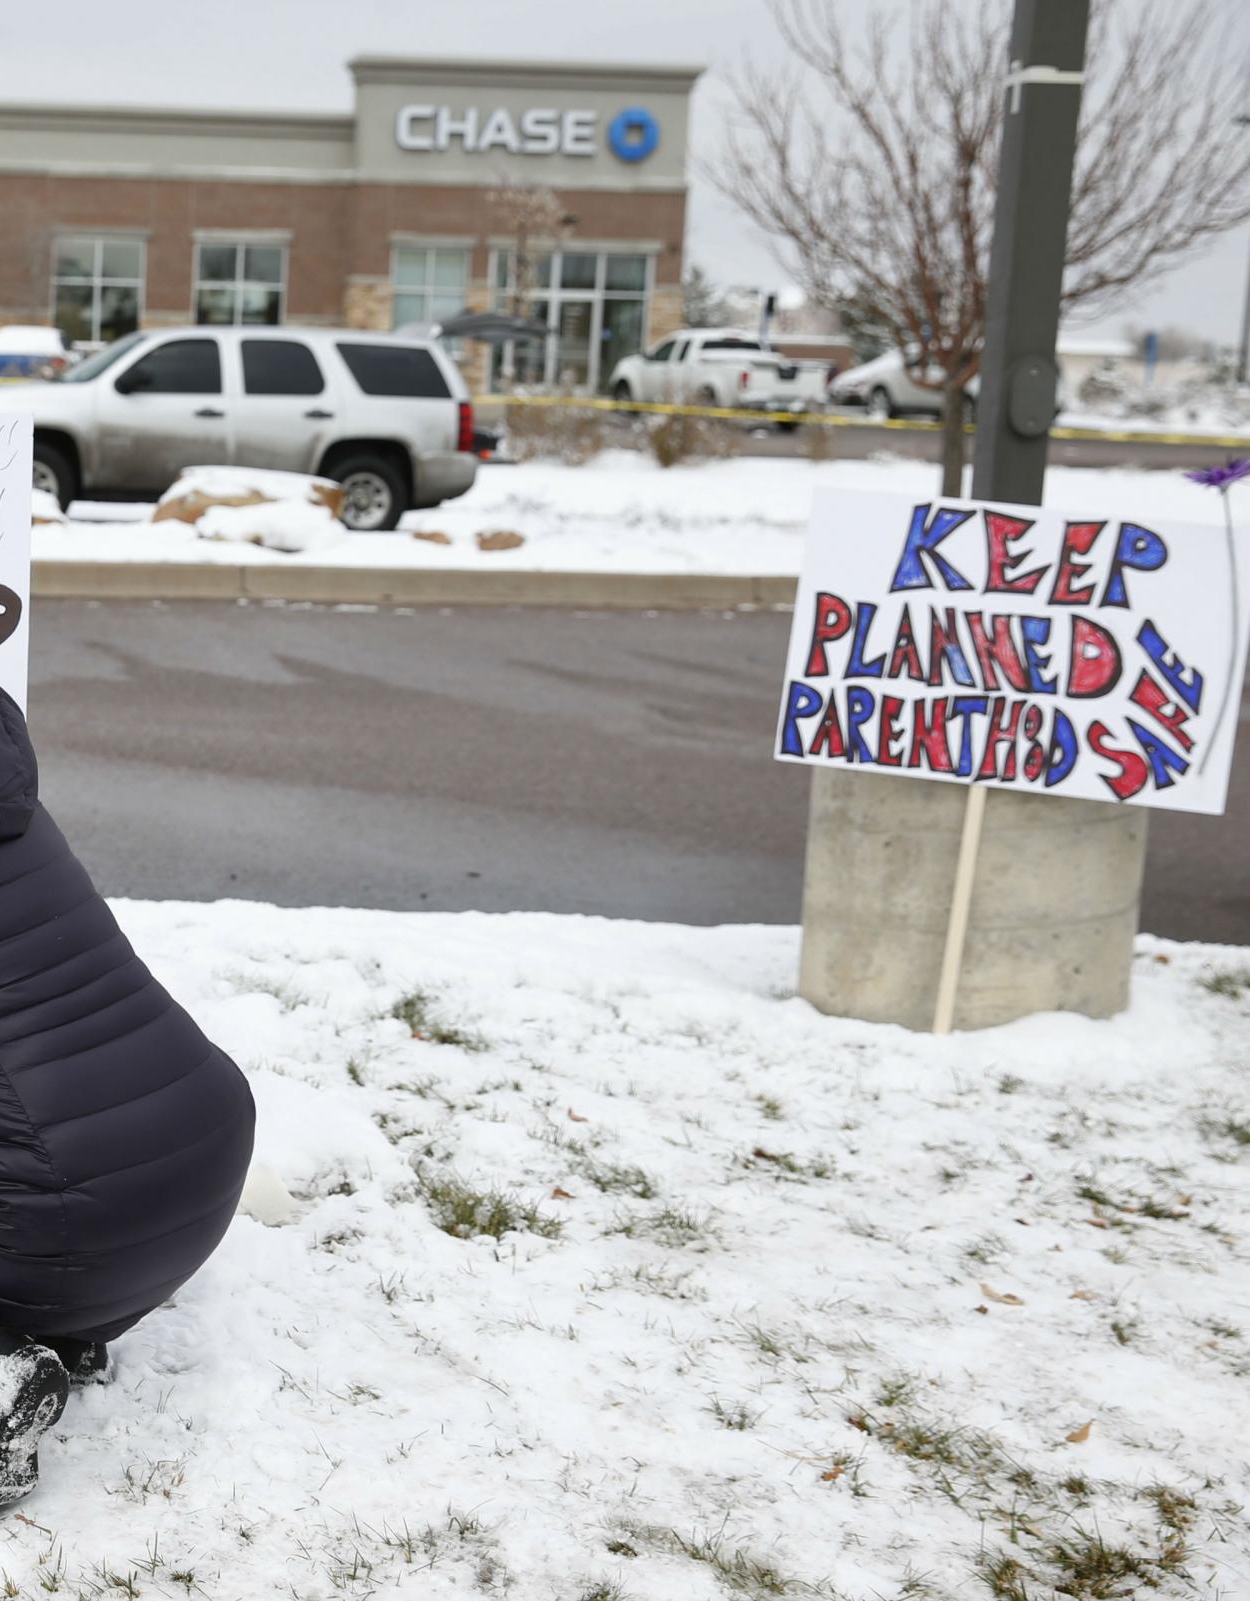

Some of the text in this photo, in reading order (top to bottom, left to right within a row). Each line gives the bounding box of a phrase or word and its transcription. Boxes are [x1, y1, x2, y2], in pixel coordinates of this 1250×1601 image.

[396, 104, 598, 156] CHASE
[888, 503, 1168, 609] KEEP
[804, 591, 1123, 698] PLANNED
[1086, 619, 1204, 800] SAFE
